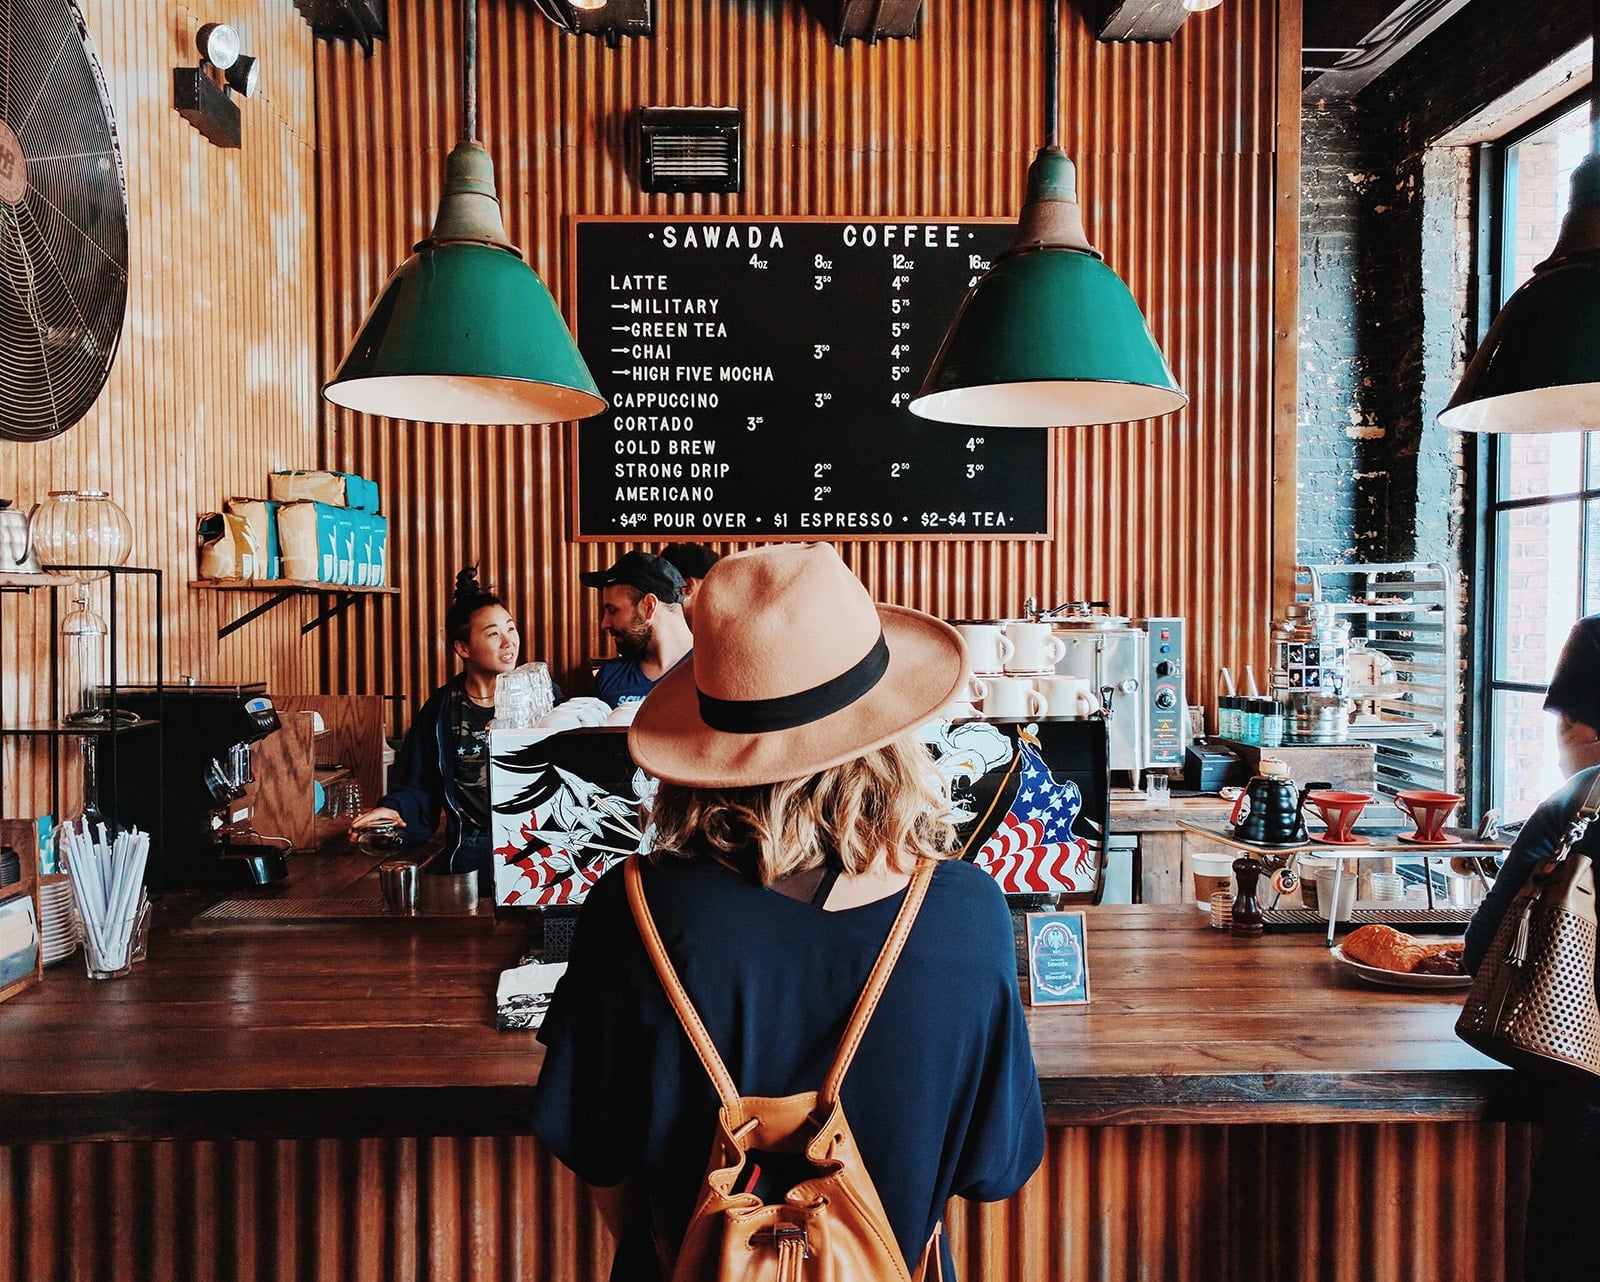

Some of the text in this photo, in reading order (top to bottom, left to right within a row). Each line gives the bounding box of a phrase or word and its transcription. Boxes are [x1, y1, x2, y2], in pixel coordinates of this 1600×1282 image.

[662, 224, 960, 249] SAWADA COFFEE
[610, 274, 668, 291] LATTE
[630, 298, 719, 315] MILITARY
[630, 322, 688, 338] GREEN
[693, 322, 728, 338] TEA
[631, 344, 671, 360] CHAI
[632, 365, 670, 382] HIGH
[676, 366, 713, 382] FIVE
[719, 366, 774, 382] MOCHA
[613, 392, 719, 409] CAPPUCCINO
[613, 416, 694, 432] CORTADO
[614, 439, 661, 455] COLD
[668, 439, 716, 455] BREW
[614, 462, 683, 478] STRONG
[690, 463, 730, 478] DRIP
[615, 486, 714, 502] AMERICANO
[653, 512, 695, 528] POUR
[702, 512, 746, 528] OVER
[773, 512, 788, 528] $1
[800, 512, 893, 528] ESPRESSO
[920, 511, 967, 527] $2-$4
[971, 511, 1006, 527] TEA
